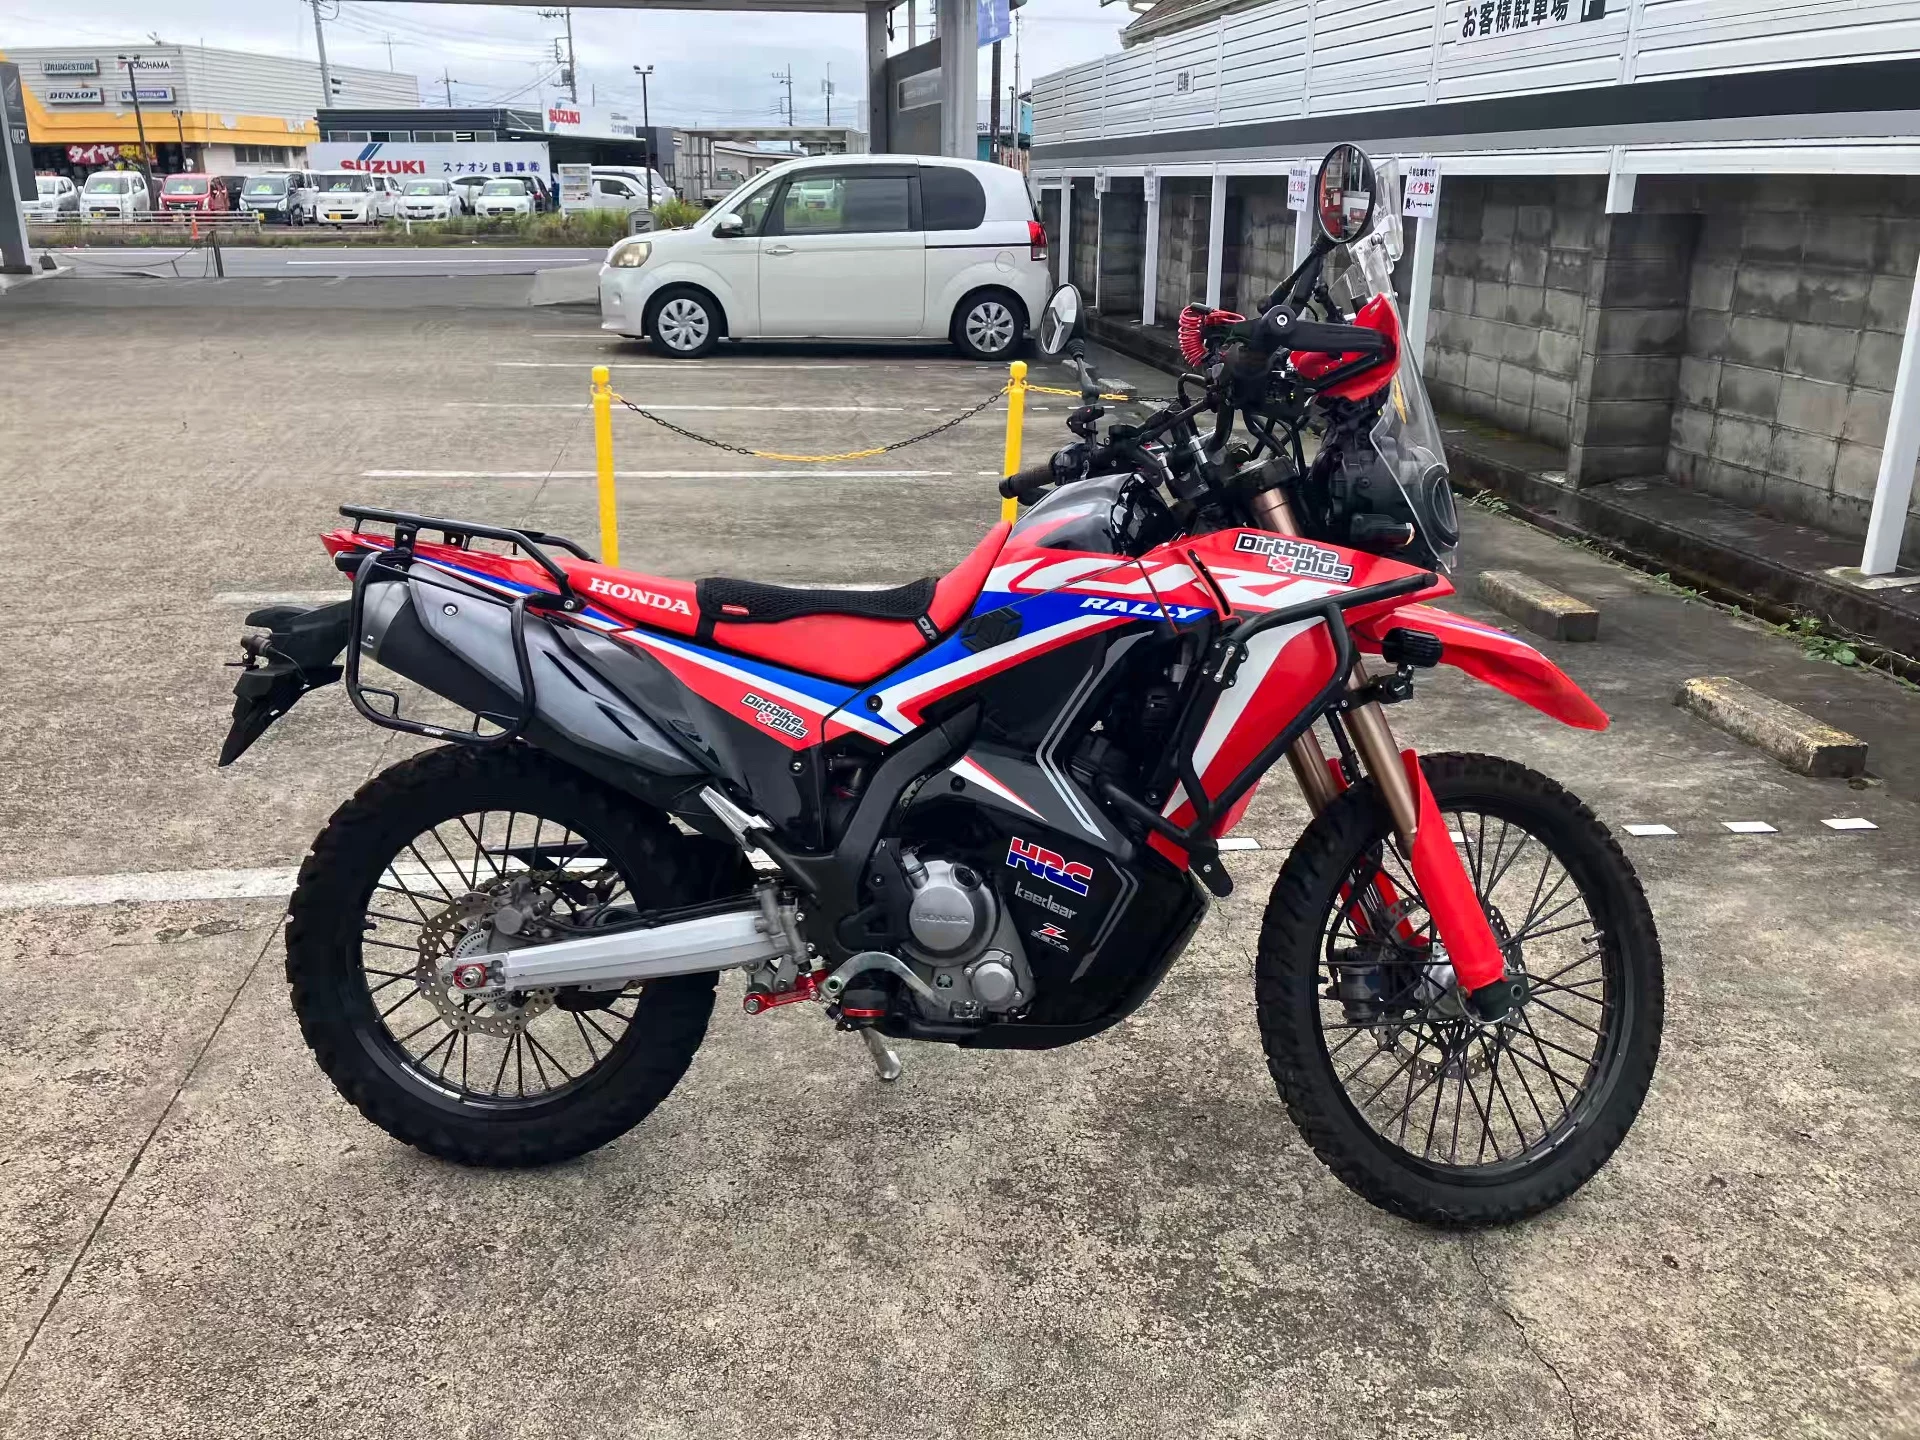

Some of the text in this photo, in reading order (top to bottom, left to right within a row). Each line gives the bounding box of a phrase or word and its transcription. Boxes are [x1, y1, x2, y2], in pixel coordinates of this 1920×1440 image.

[130, 61, 169, 69] OKOHAMA
[49, 91, 97, 99] DUNLOP
[549, 109, 580, 124] SUZUKI
[69, 145, 115, 163] タイヤ
[340, 160, 425, 174] SUZUKI
[1238, 535, 1336, 563] Dirtbike
[1294, 558, 1350, 578] plus
[588, 578, 692, 616] HONDA
[1079, 597, 1203, 619] RALLY
[743, 694, 803, 725] Dirtbike
[770, 718, 806, 736] plus
[1006, 836, 1093, 897] HRC
[915, 912, 969, 924] HONDA
